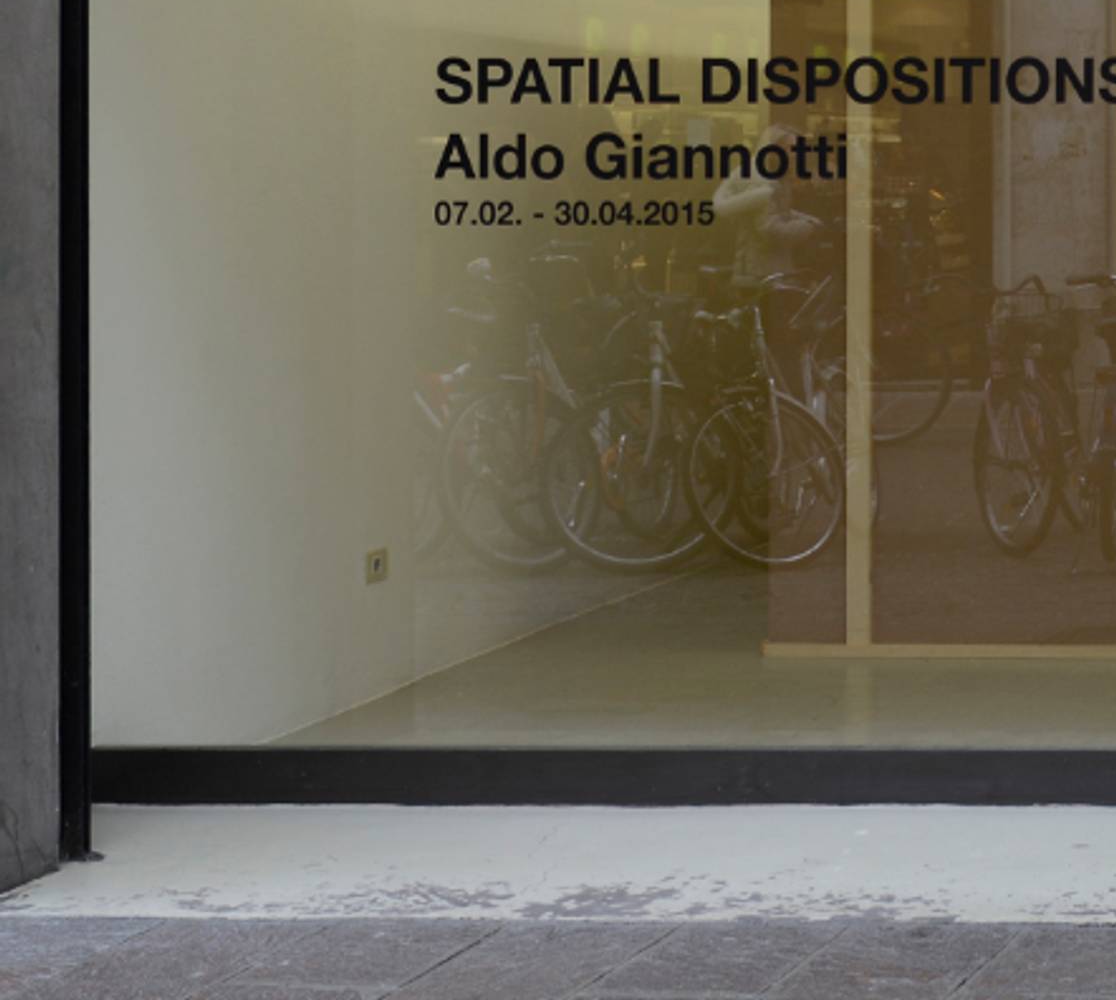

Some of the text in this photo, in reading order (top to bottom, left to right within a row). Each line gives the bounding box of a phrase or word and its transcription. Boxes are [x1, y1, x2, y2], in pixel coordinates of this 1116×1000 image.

[437, 58, 680, 104] SPATIAL
[436, 132, 846, 180] Aldo Giannotti
[435, 201, 521, 225] 07.02.
[555, 201, 715, 226] 30.04.2015
